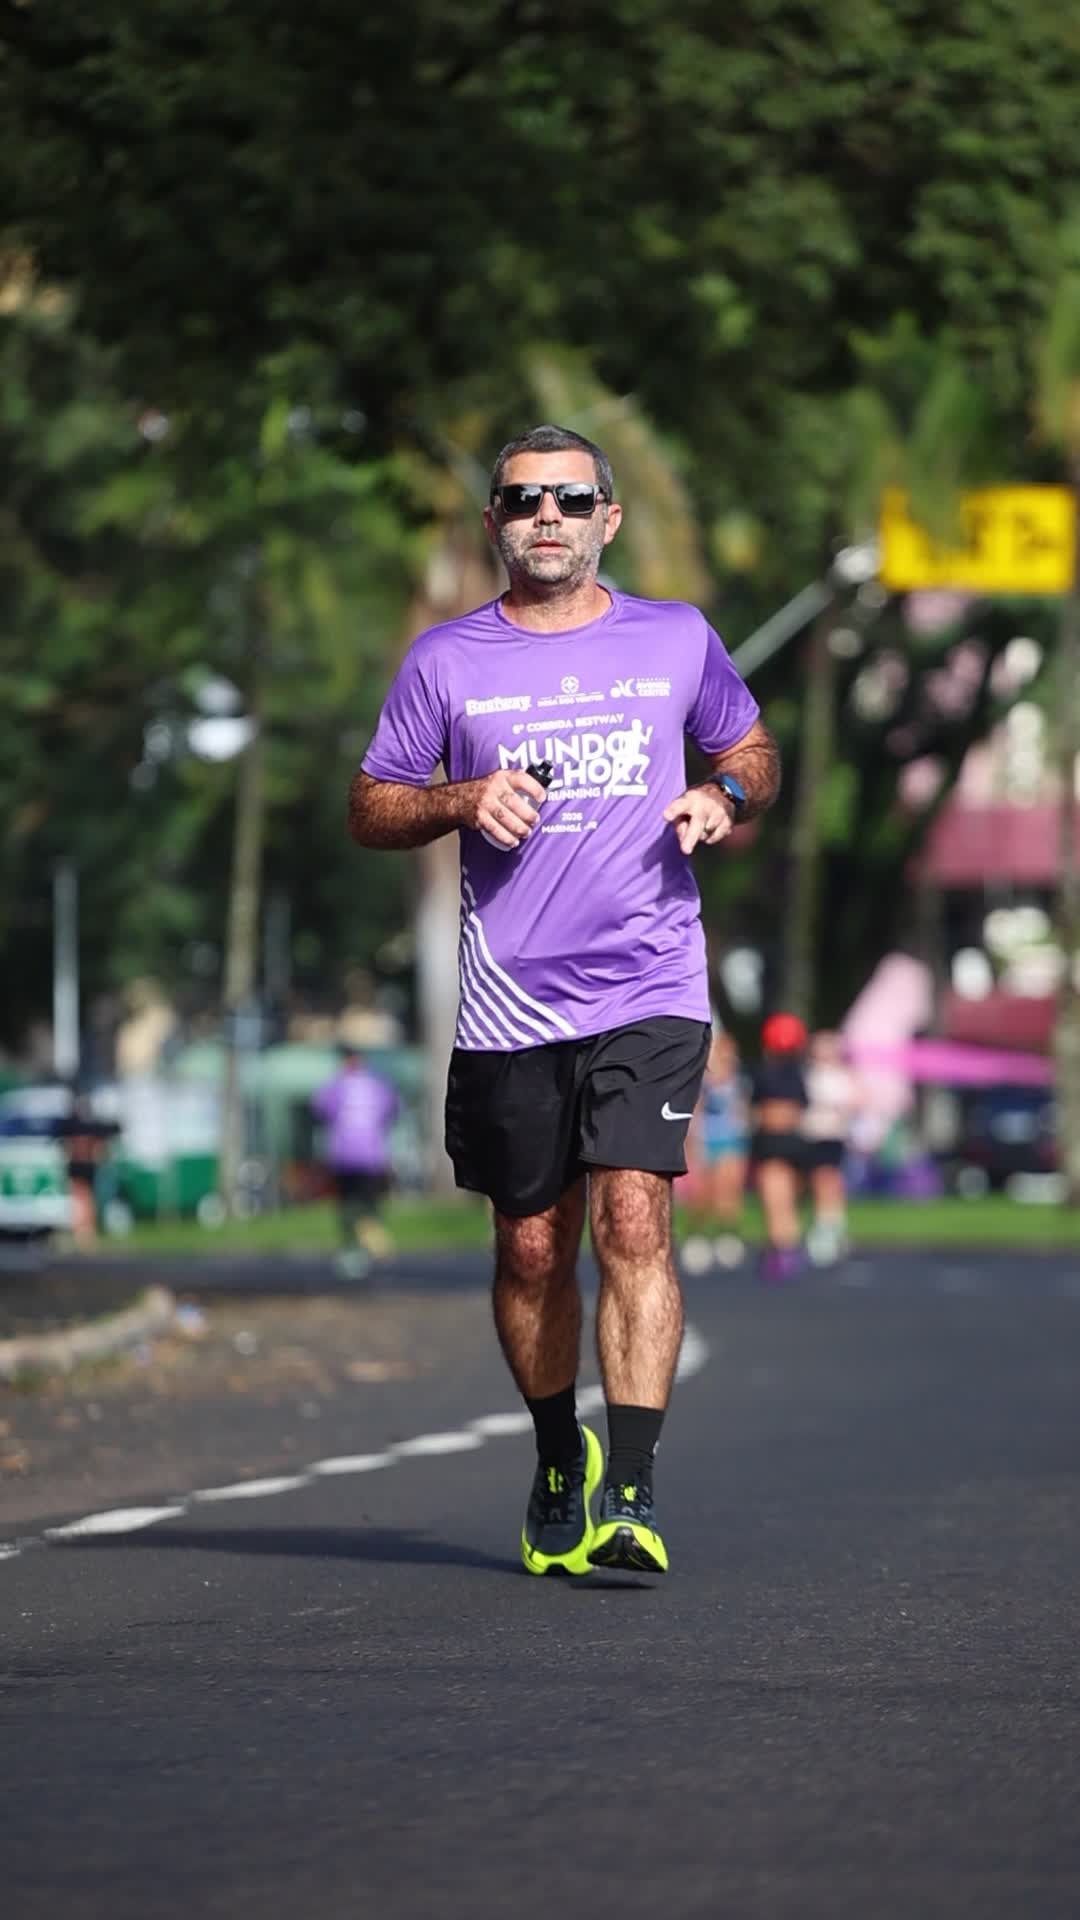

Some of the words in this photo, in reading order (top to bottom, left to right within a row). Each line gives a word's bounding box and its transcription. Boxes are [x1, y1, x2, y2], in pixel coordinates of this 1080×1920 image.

[526, 719, 574, 733] CORRIDA
[575, 713, 624, 728] BESTWAY
[498, 730, 634, 770] MUNDO
[547, 787, 601, 801] RUNNING
